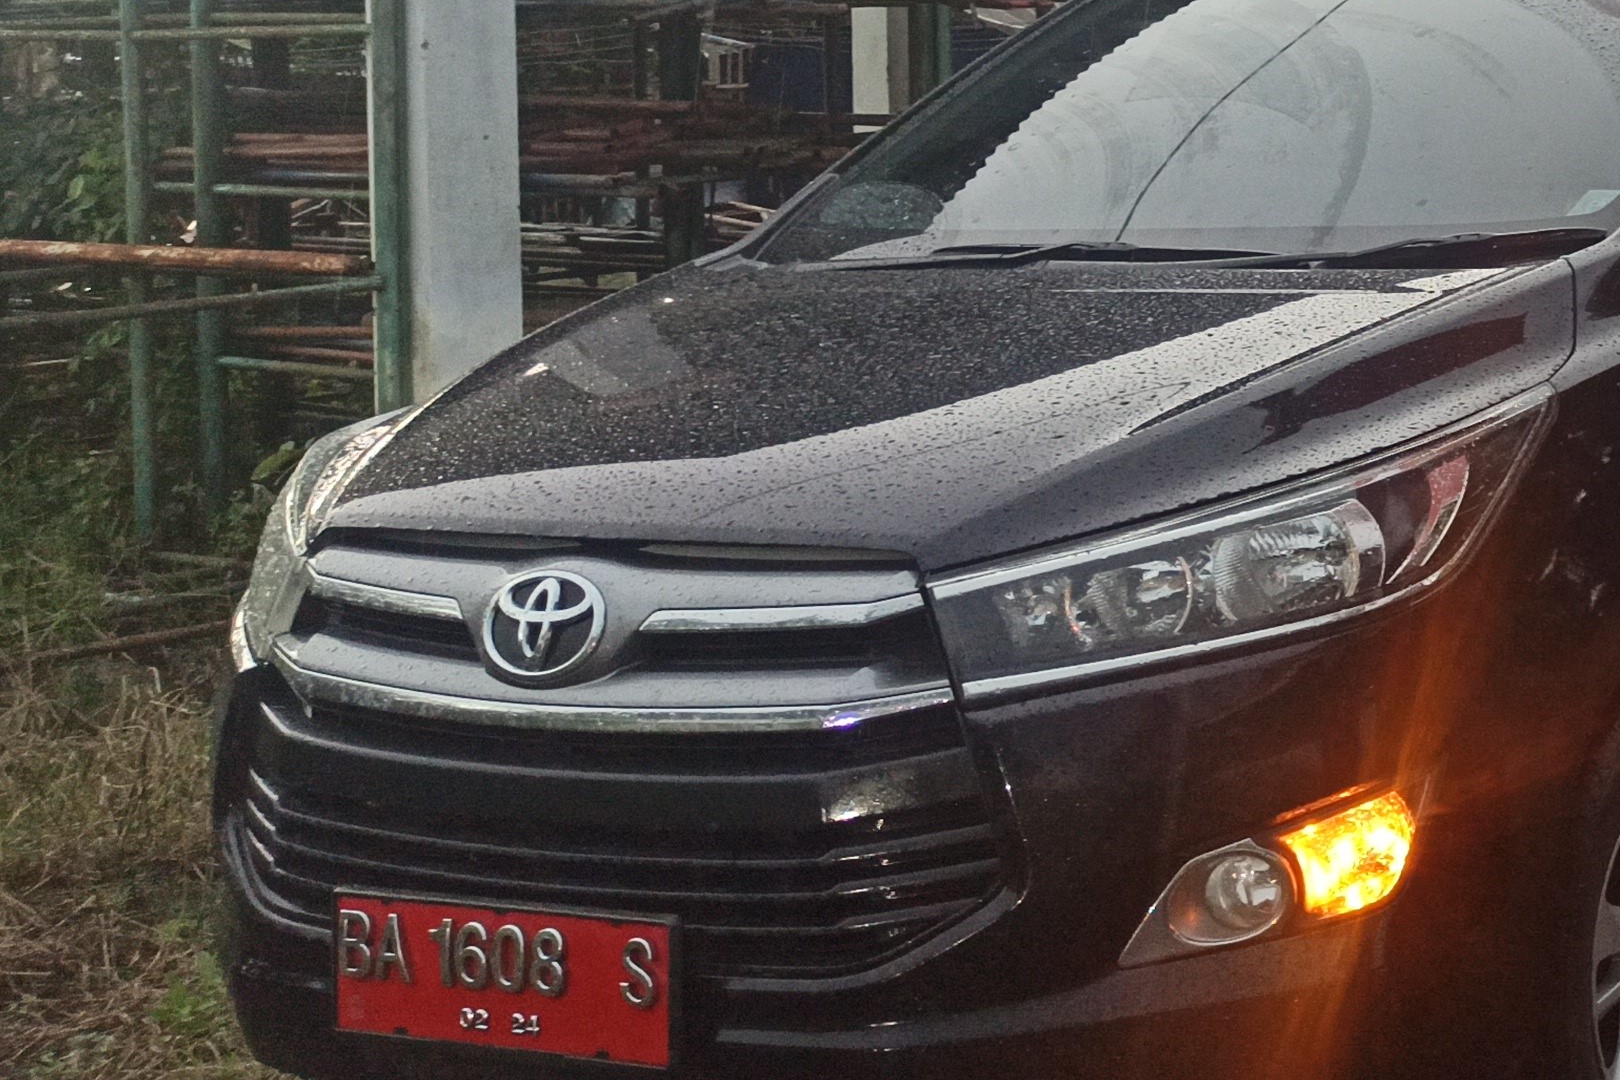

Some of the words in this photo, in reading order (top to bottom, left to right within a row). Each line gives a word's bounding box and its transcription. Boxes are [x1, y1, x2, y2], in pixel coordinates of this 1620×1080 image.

[339, 909, 411, 984] BA
[427, 917, 565, 999] 1608
[618, 937, 656, 1009] S
[460, 1007, 490, 1030] 02
[511, 1012, 540, 1036] 24
